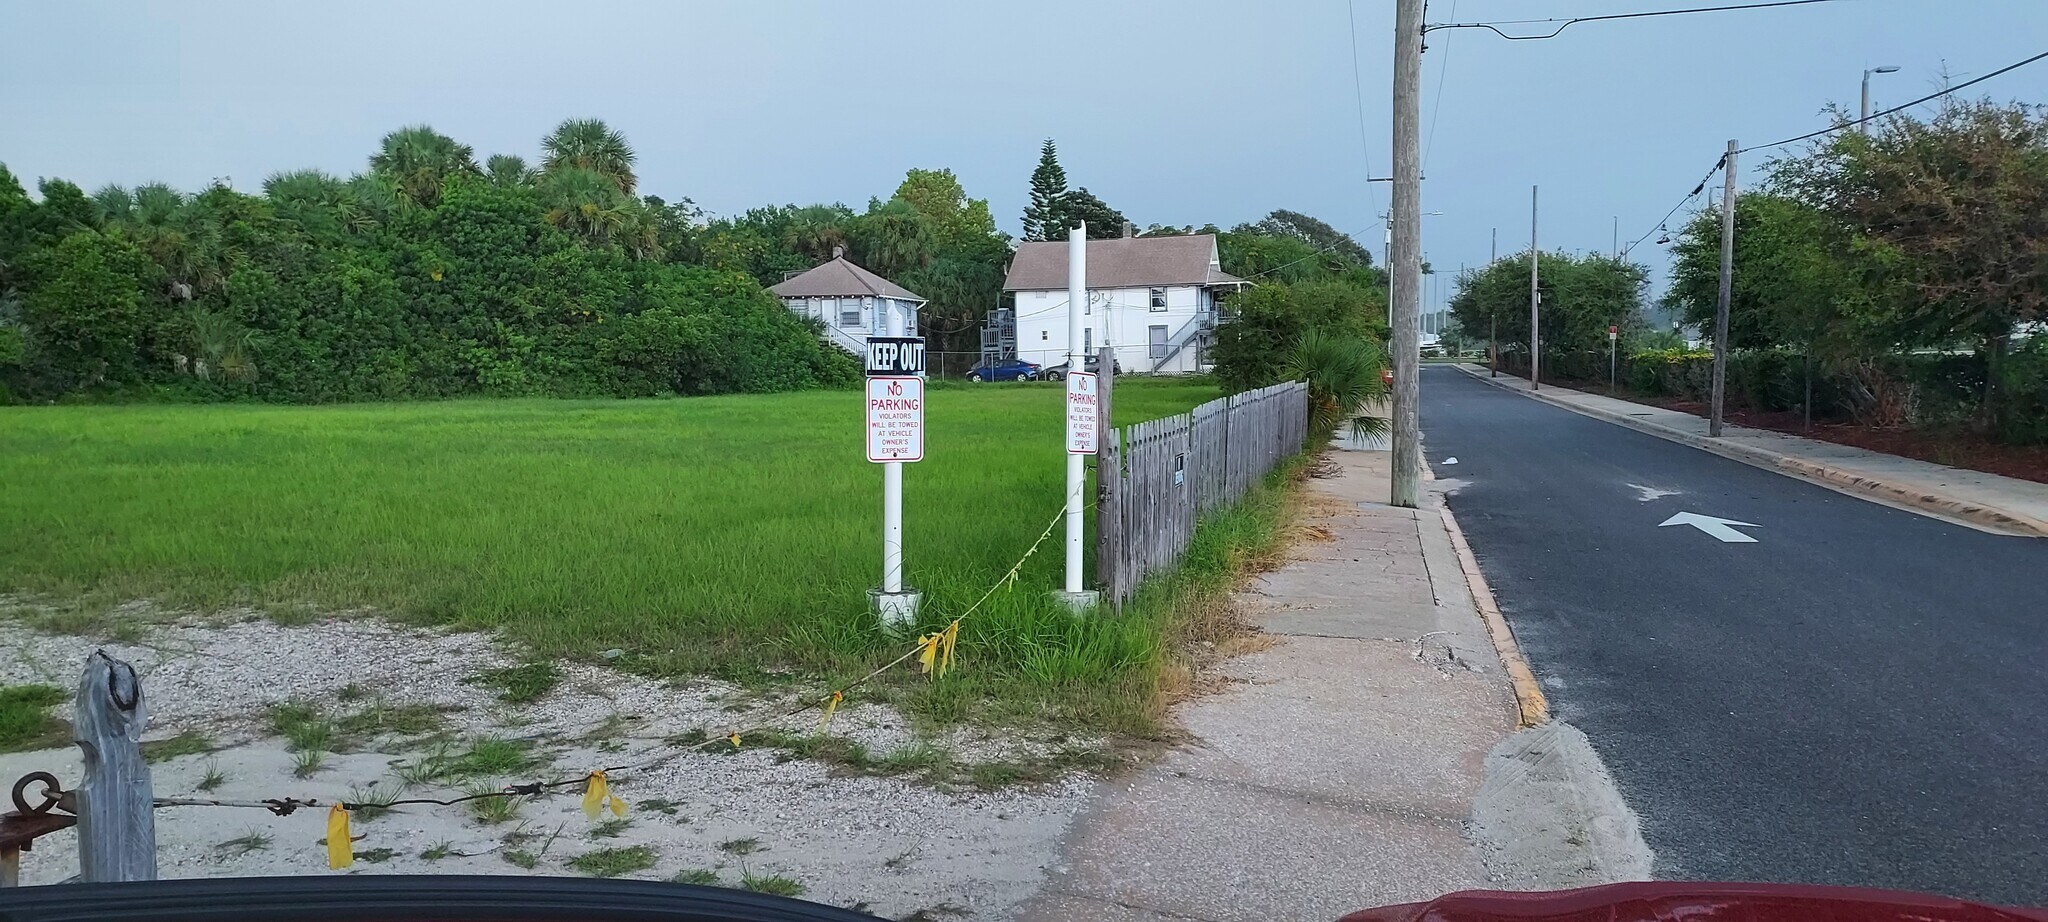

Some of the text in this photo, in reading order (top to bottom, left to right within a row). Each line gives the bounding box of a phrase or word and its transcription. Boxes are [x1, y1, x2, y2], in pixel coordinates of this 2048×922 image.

[867, 342, 924, 371] KEEP OUT
[887, 385, 902, 396] NO
[1078, 380, 1087, 390] NO
[1070, 392, 1096, 405] PARKING
[871, 399, 918, 410] PARKING
